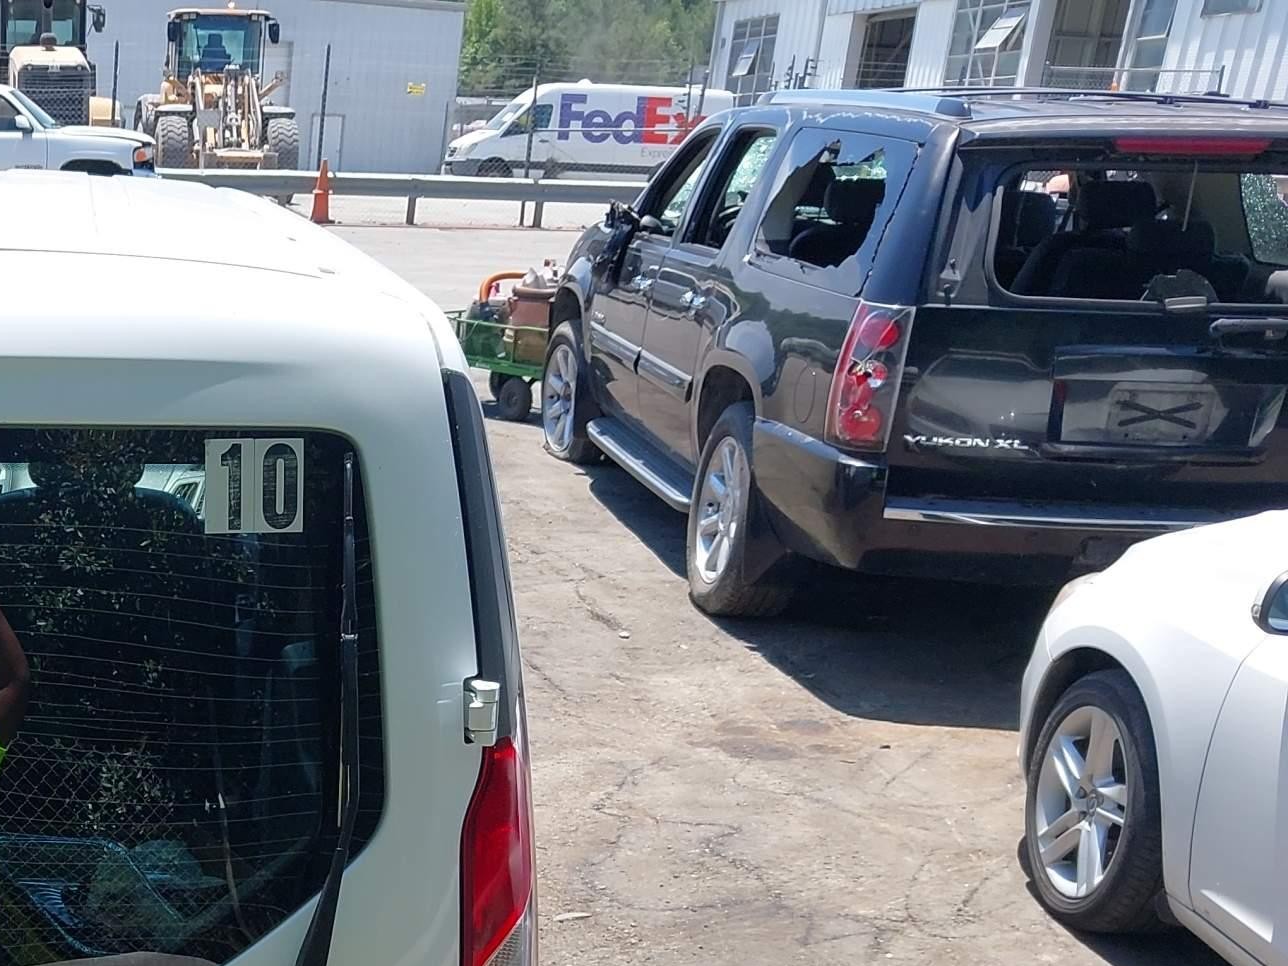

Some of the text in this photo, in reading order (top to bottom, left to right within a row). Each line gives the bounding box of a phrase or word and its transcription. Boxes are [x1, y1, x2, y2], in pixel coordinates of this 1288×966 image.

[557, 93, 708, 145] FedEx
[903, 434, 1030, 450] YUKON XL
[220, 442, 298, 530] 10
